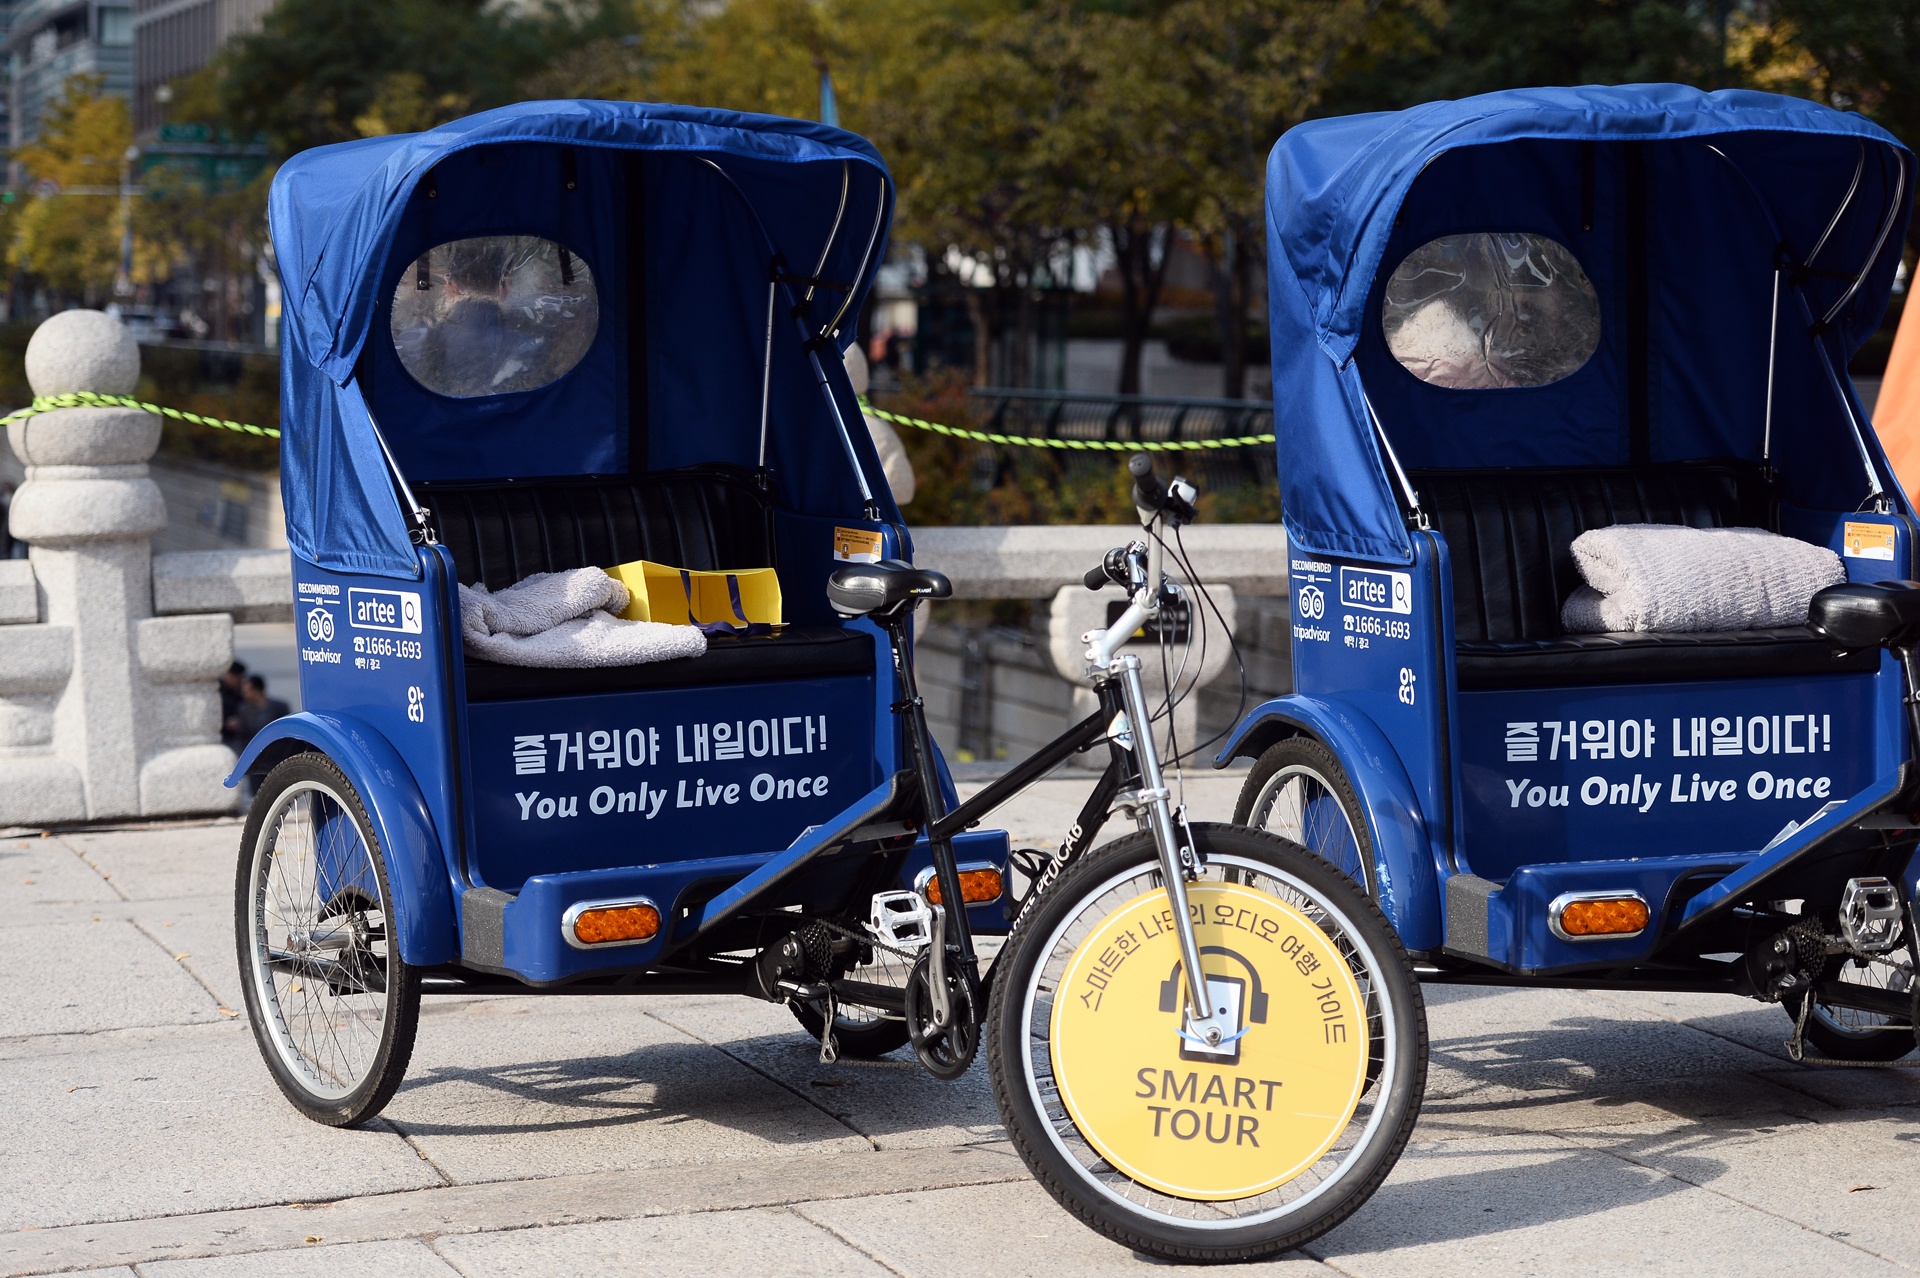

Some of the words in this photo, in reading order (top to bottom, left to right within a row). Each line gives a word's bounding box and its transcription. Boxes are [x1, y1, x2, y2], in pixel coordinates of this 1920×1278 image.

[1291, 559, 1332, 574] RECOMMENDED
[1307, 573, 1315, 583] ON
[297, 582, 340, 596] RECOMMENDED
[315, 596, 323, 606] ON
[1348, 576, 1387, 604] artee
[357, 597, 396, 624] artee
[1293, 623, 1331, 643] tripadvisor
[1355, 614, 1411, 641] 1666-1693
[301, 646, 342, 666] tripadvisor
[365, 636, 422, 660] 1666-1693
[512, 726, 660, 775] 즐거워야
[676, 715, 827, 763] 내일이다!
[1504, 718, 1656, 762] 즐거워야
[1672, 714, 1831, 757] 내일이다!
[514, 791, 578, 821] You
[588, 781, 668, 820] Only
[676, 778, 740, 808] Live
[749, 773, 829, 802] Once
[1505, 778, 1570, 808] You
[1580, 773, 1662, 813] Only
[1670, 773, 1737, 803] Live
[1747, 770, 1831, 800] Once
[1036, 820, 1083, 894] PEDICAB
[1080, 930, 1142, 1012] 스마트한
[1213, 904, 1280, 943] 오디오
[1280, 935, 1322, 977] 여행
[1311, 977, 1347, 1044] 가이드
[1135, 1066, 1283, 1112] SMART
[1147, 1105, 1260, 1148] TOUR
